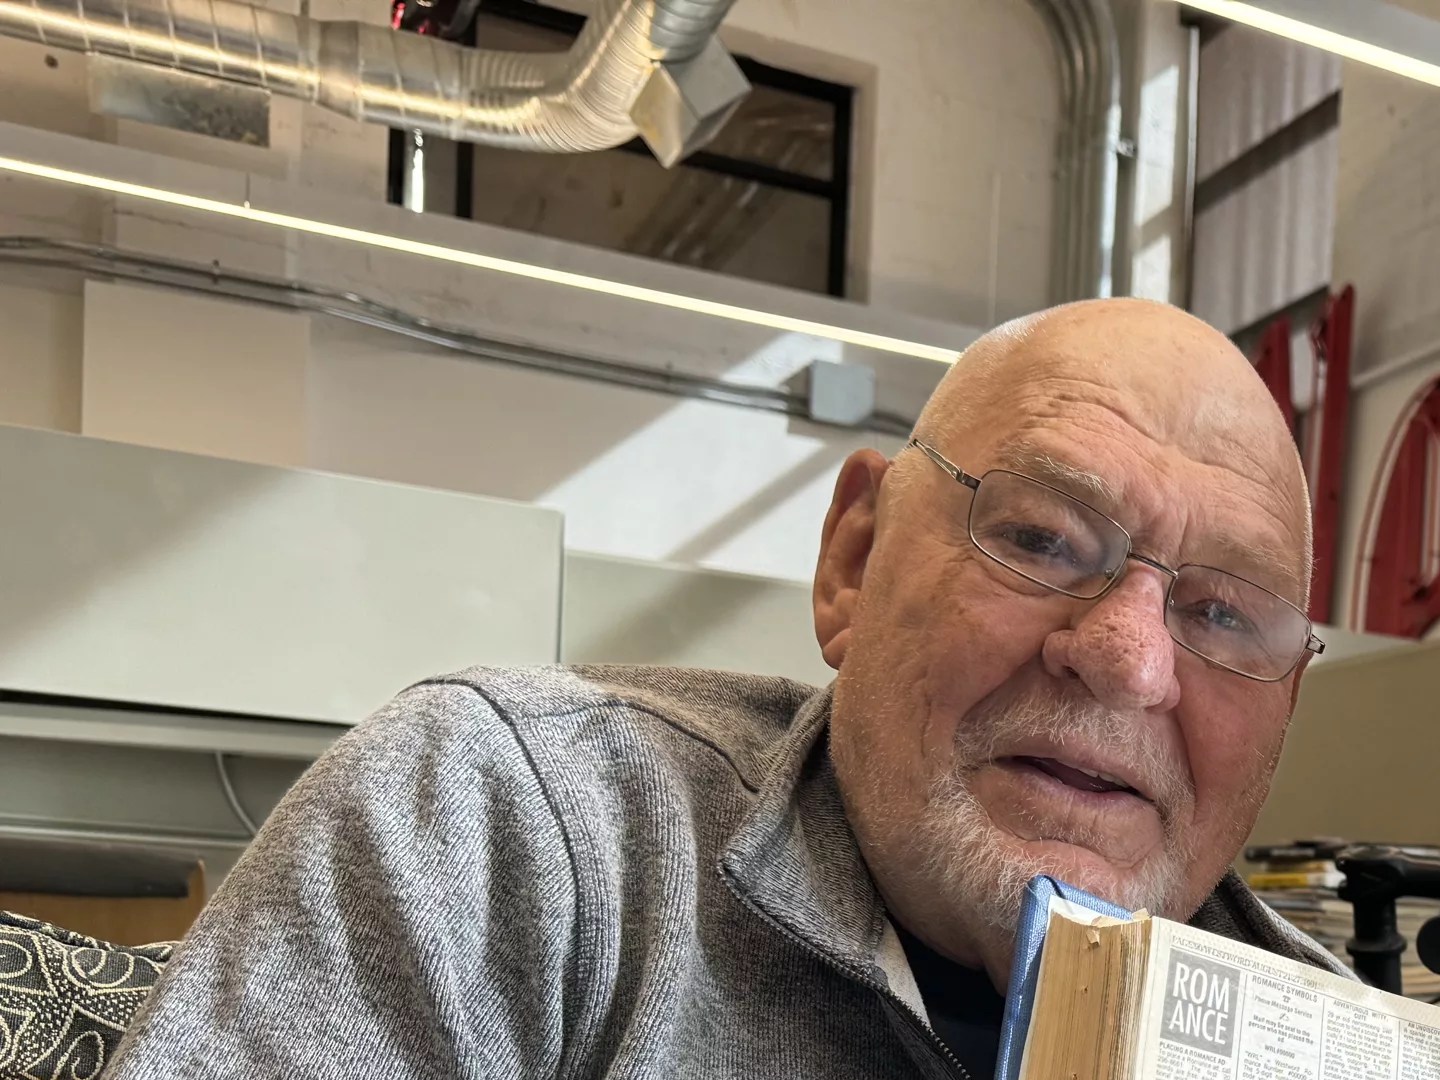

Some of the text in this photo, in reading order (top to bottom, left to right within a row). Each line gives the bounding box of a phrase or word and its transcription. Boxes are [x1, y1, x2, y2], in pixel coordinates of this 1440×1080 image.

[1172, 962, 1230, 1012] ROM
[1252, 975, 1317, 1001] ROMANCE SYMBOLS
[1168, 1000, 1229, 1044] ANCE
